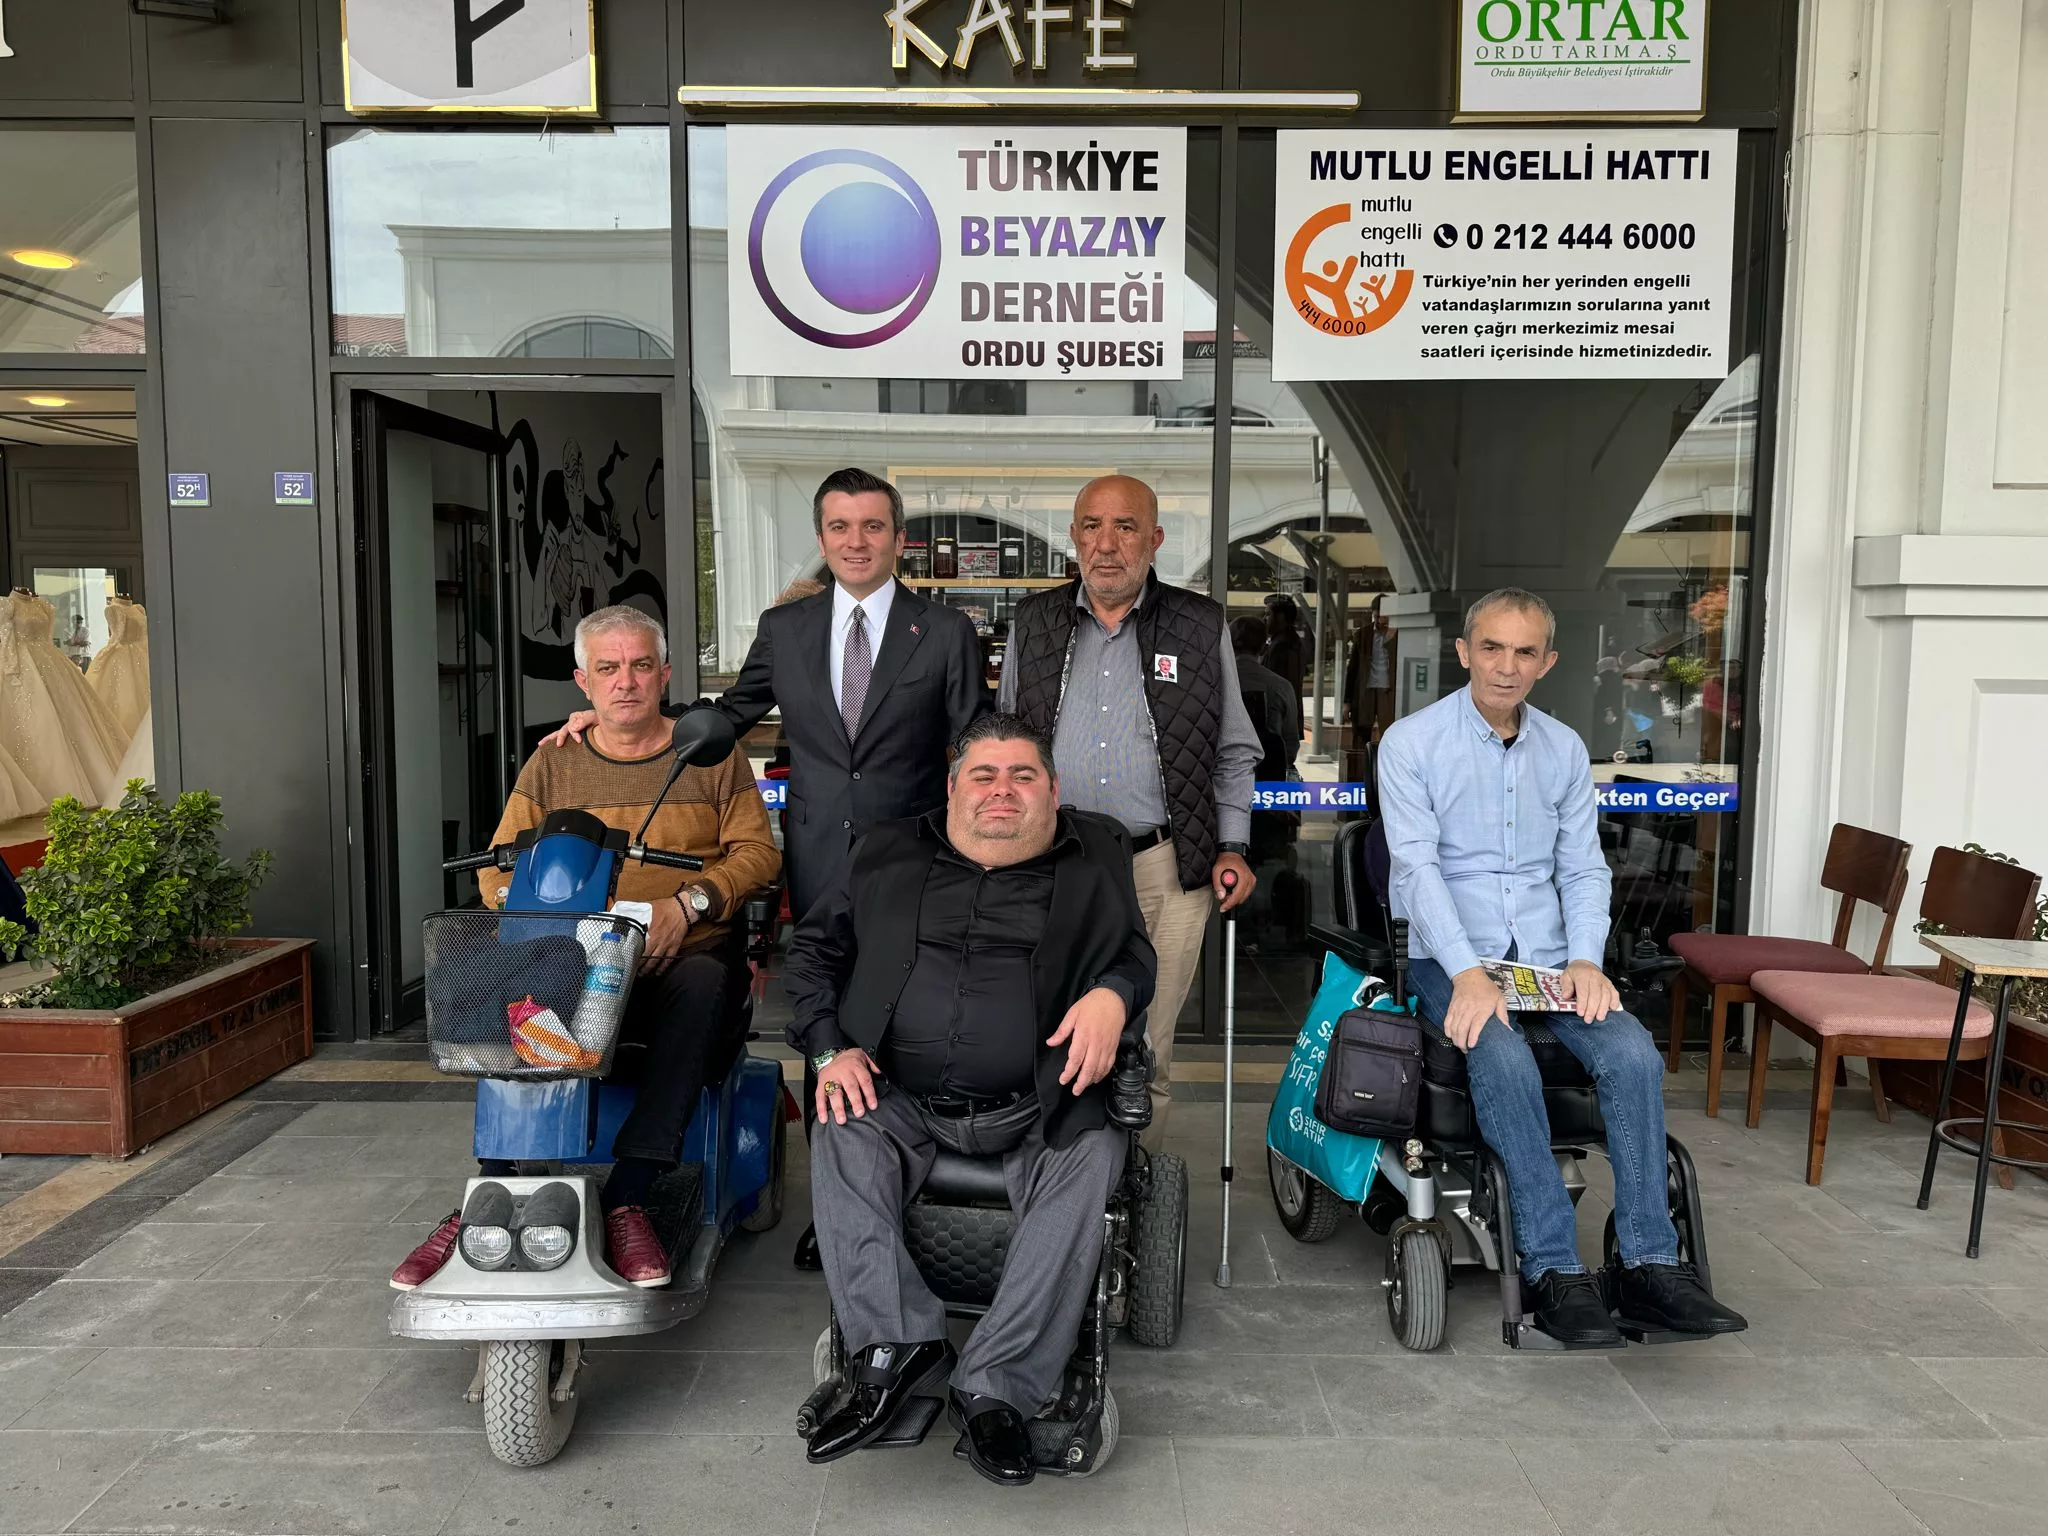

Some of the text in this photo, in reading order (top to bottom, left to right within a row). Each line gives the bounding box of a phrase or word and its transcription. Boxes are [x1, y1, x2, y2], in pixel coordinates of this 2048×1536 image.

[1477, 0, 1690, 42] ORTAR
[883, 0, 1138, 70] KAFE
[1476, 45, 1543, 60] ORDU
[1552, 44, 1630, 59] TARIM
[1490, 65, 1673, 79] Ordu Büyükşehir Belediyesi İştirakidir
[958, 140, 1159, 192] TÜRKİYE
[1310, 143, 1710, 181] MUTLU ENGELLİ HATTI
[1361, 195, 1412, 212] mutlu
[961, 215, 1167, 257] BEYAZAY
[1361, 223, 1422, 245] engelli
[1466, 223, 1696, 250] 0 212 444 6000
[1360, 250, 1405, 268] hattı
[1522, 274, 1550, 288] her
[1555, 274, 1628, 291] yerinden
[1633, 274, 1691, 291] engelli
[961, 271, 1164, 323] DERNEĞİ
[1422, 298, 1711, 314] vatandaşlarımızın sorularına yanıt
[1299, 299, 1367, 335] 444 6000
[1421, 321, 1675, 338] veren çağrı merkezimiz mesai
[961, 340, 1045, 367] ORDU
[1420, 344, 1712, 361] saatleri içerisinde hizmetinizdedir.
[1252, 790, 1312, 809] aşam
[1320, 787, 1367, 805] Kali
[1594, 788, 1648, 806] kten
[1656, 787, 1730, 811] Geçer
[1304, 1115, 1327, 1137] SIFIR
[1303, 1128, 1325, 1147] ATIK
